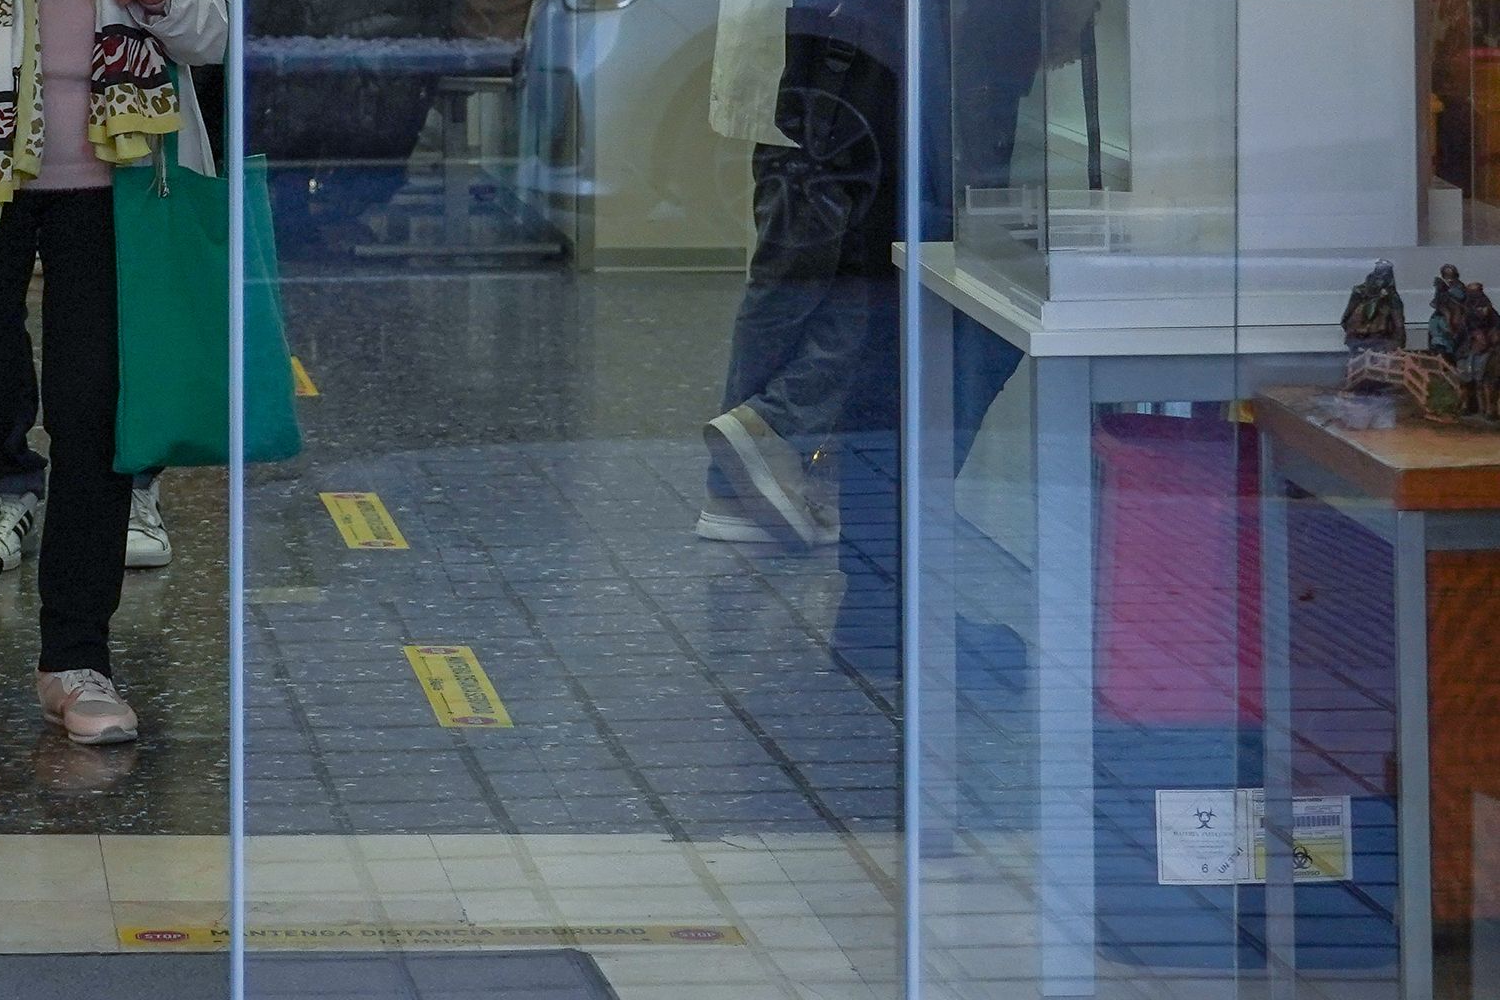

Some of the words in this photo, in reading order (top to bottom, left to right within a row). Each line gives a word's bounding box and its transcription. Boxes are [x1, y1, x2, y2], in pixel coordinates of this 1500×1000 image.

[1202, 863, 1209, 874] 6
[361, 929, 493, 937] DISTANCIA
[502, 928, 647, 936] SEGURIDAD
